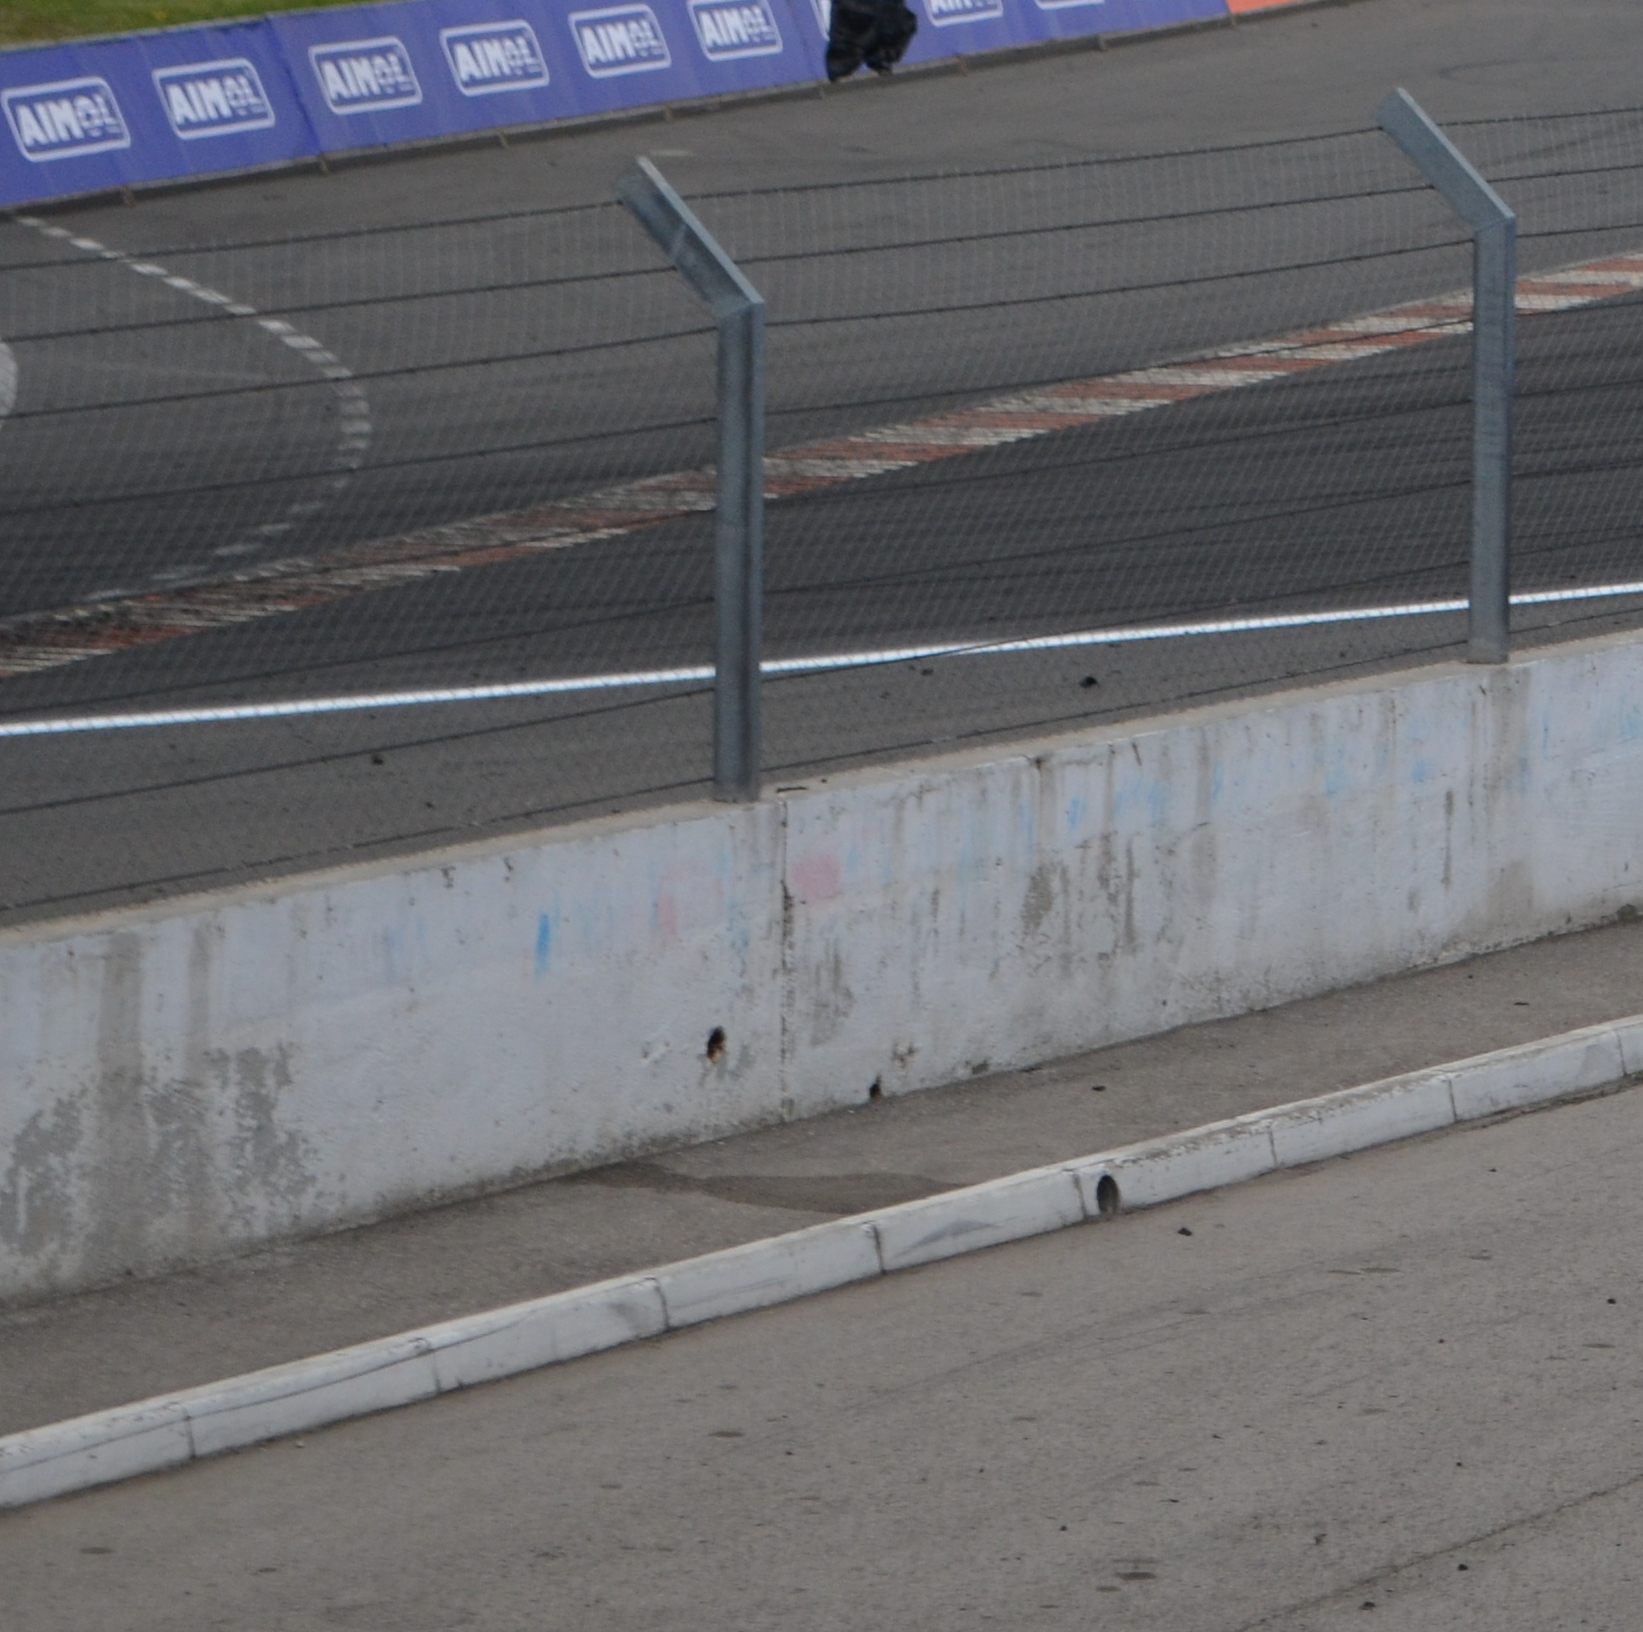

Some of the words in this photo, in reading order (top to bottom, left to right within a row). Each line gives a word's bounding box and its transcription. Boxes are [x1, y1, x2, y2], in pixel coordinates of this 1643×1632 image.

[581, 19, 665, 65] AIMOL
[700, 5, 774, 49] AIMOL
[320, 52, 414, 102] AIMOL
[453, 36, 542, 83] AIMOL
[15, 92, 122, 147] AIMOL
[165, 74, 266, 126] AIMOL
